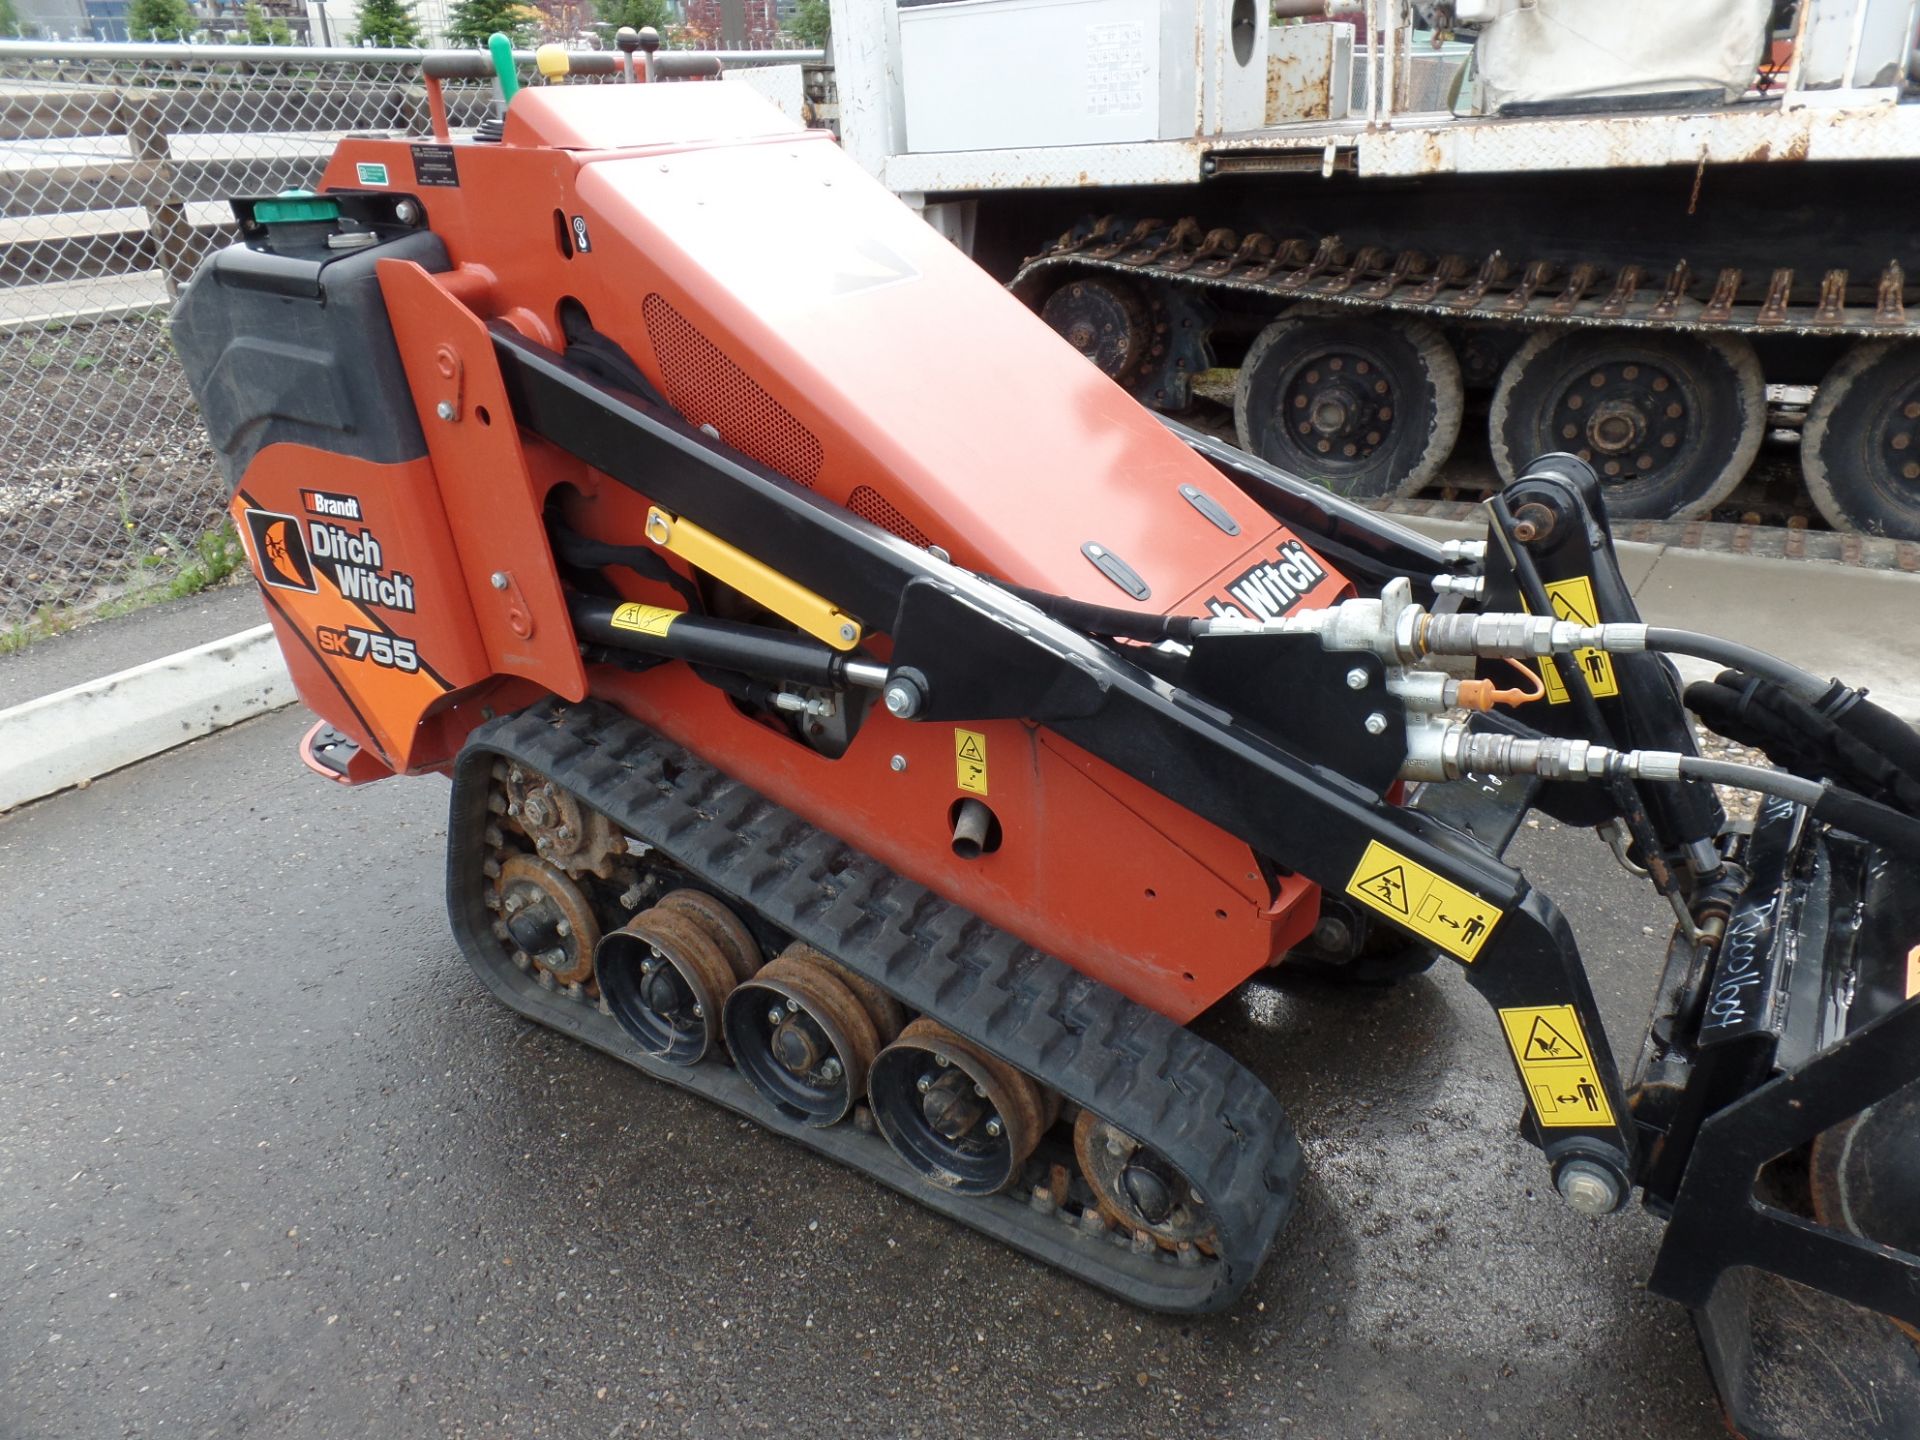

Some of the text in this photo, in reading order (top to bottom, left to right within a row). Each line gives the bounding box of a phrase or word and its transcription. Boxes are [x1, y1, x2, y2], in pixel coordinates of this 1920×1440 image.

[314, 493, 359, 518] Brandt
[309, 523, 381, 566] Ditch
[334, 563, 414, 610] Witch
[1230, 546, 1323, 618] Witch
[318, 629, 418, 670] SK755
